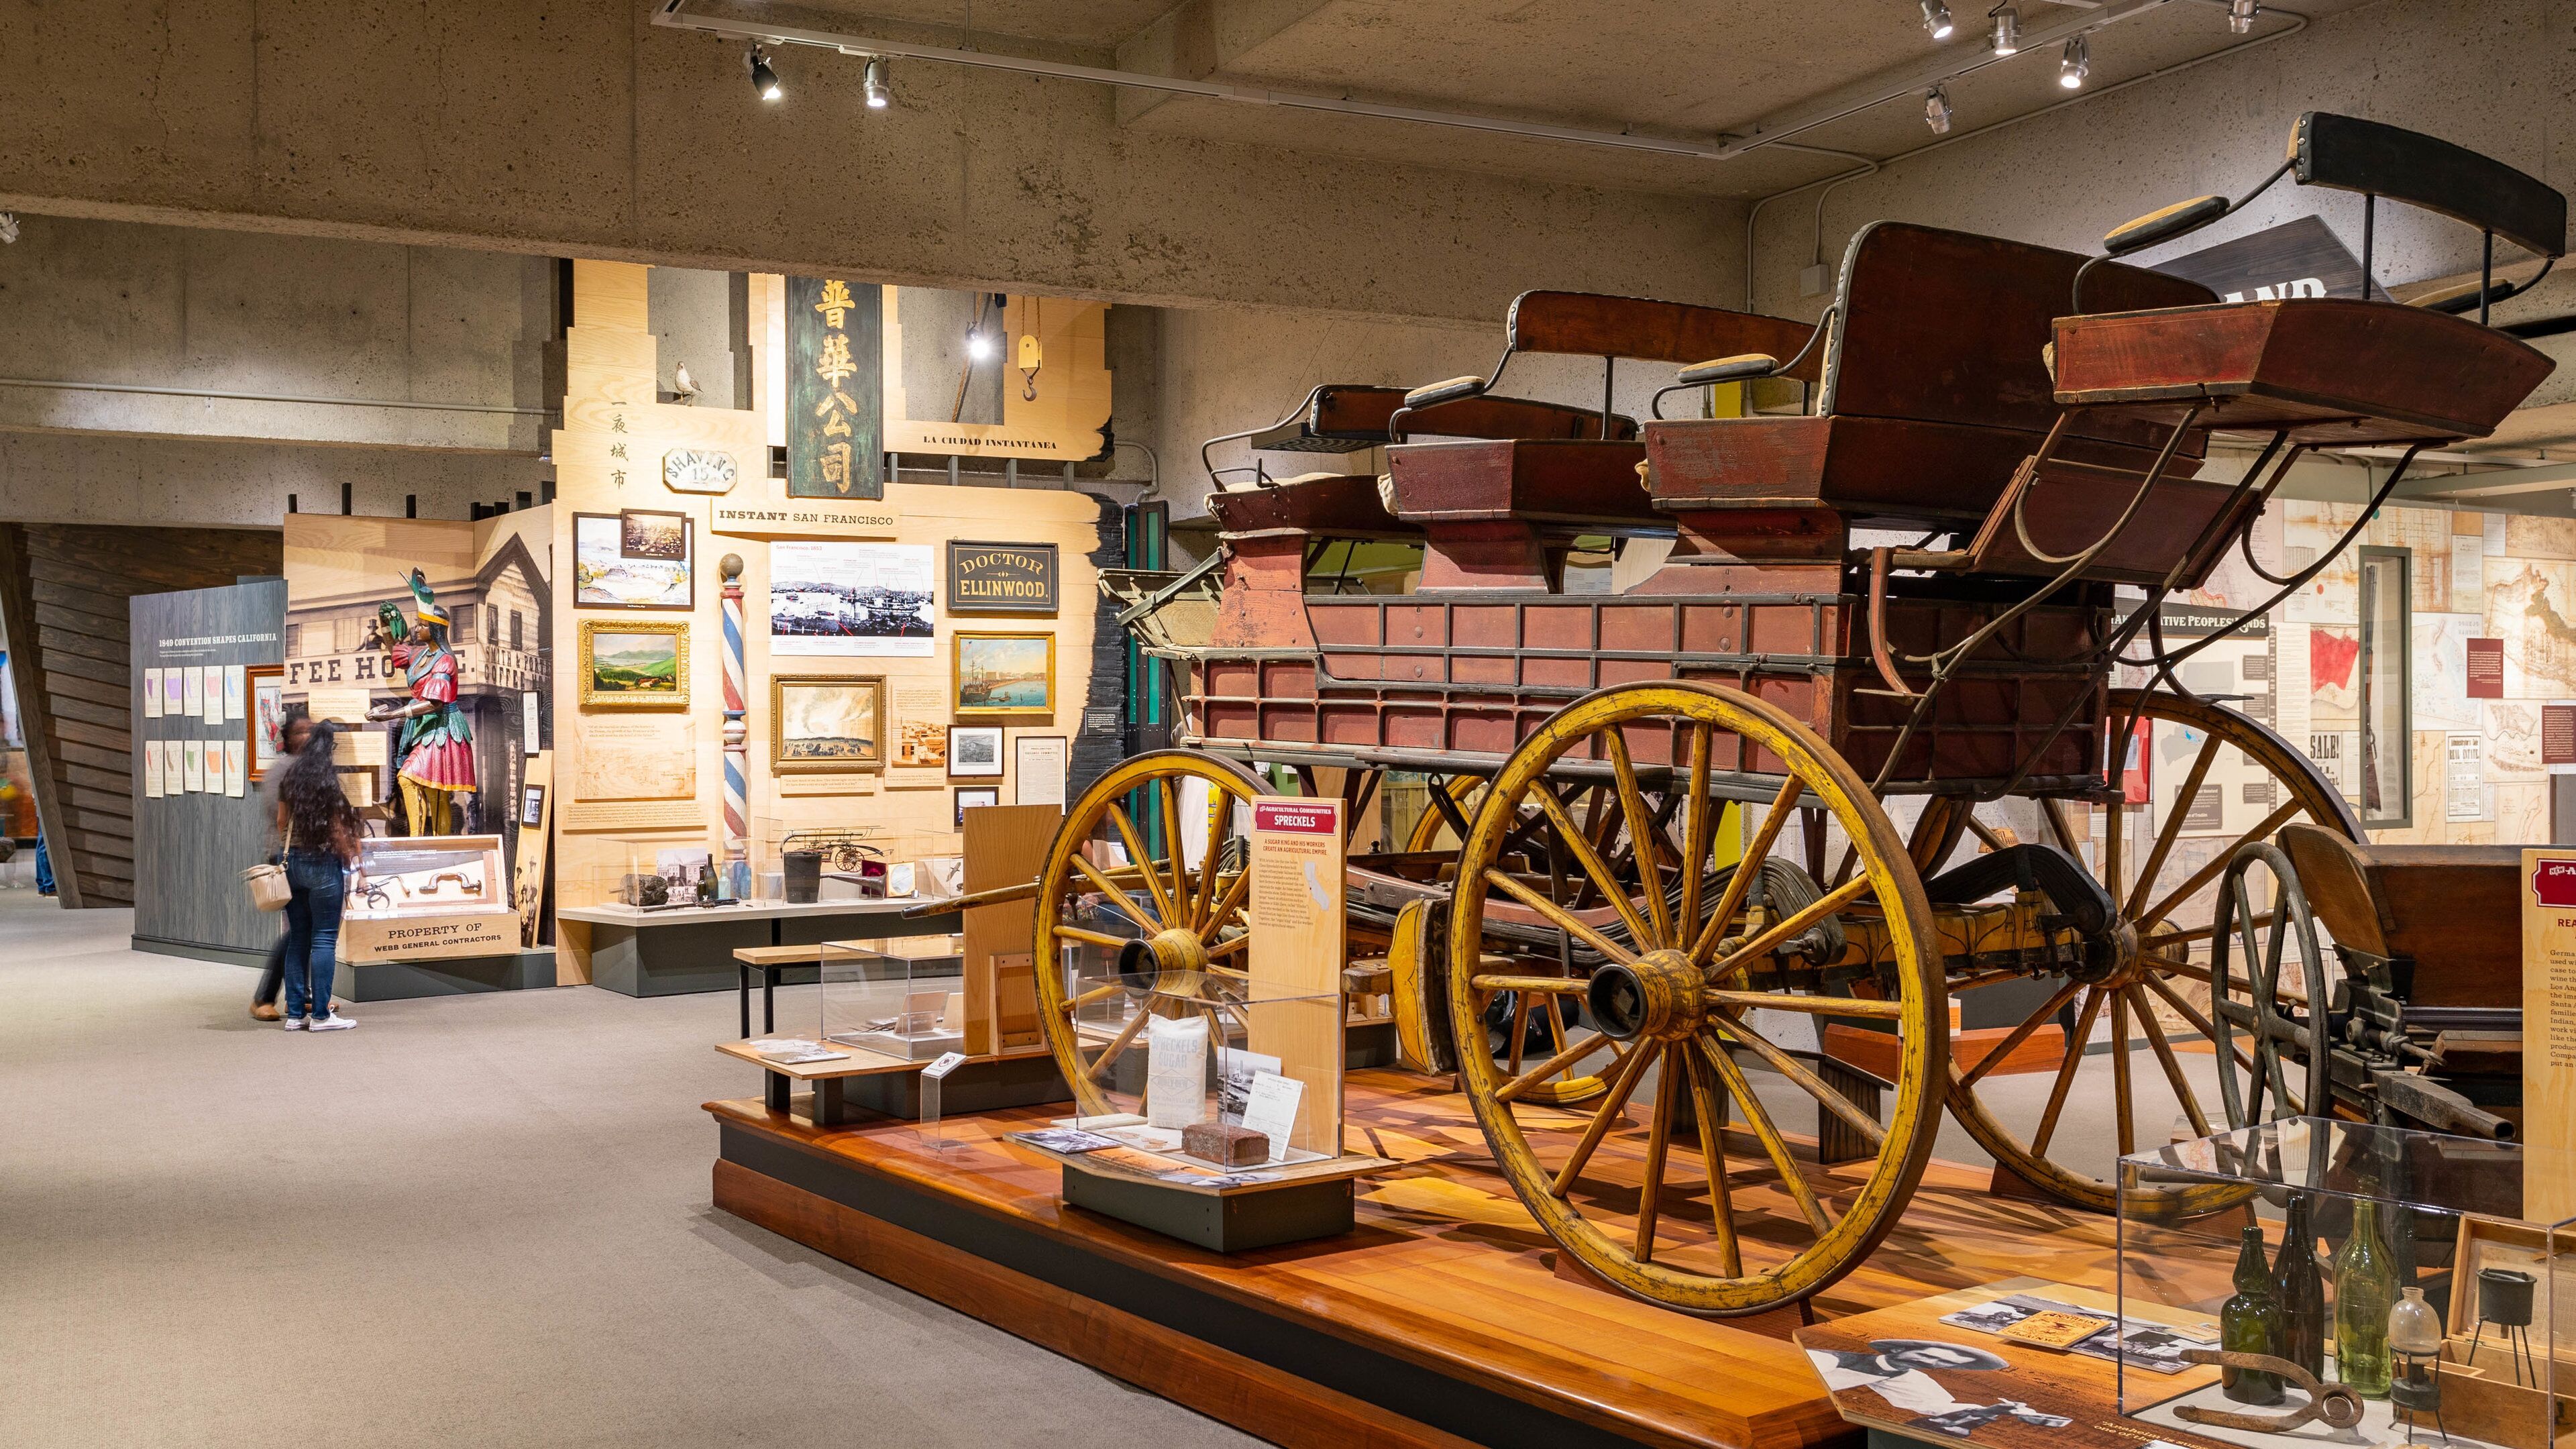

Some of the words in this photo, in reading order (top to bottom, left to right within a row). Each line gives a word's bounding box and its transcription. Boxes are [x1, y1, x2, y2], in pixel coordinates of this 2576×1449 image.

[610, 401, 629, 490] 一夜城市
[941, 437, 981, 445] CIUDAD
[985, 439, 1057, 449] INSTANTÁNEA
[719, 510, 787, 521] INSTANT
[793, 513, 818, 522] SAN
[824, 515, 893, 525] FRANCISCO
[959, 553, 1043, 575] DOCTOR
[960, 580, 1048, 598] ELLINWOOD.
[159, 639, 173, 647] 1849
[174, 637, 211, 647] CONVENTION
[212, 635, 236, 645] SHAPES
[237, 633, 276, 642] CALIFORNIA
[486, 646, 511, 667] SMITH
[290, 659, 341, 684] FEE
[356, 650, 475, 680] HOE.
[2310, 735, 2339, 759] SALE!
[1275, 815, 1316, 827] SPRECKELS
[388, 924, 460, 939] PROPERTY
[466, 923, 482, 932] OF
[374, 945, 399, 953] WEBB
[402, 941, 439, 949] GENERAL
[443, 934, 502, 945] CONTRACTORS
[1152, 1036, 1197, 1054] SPRECKELS
[1159, 1051, 1187, 1069] SUGAR
[2094, 1426, 2116, 1434] one
